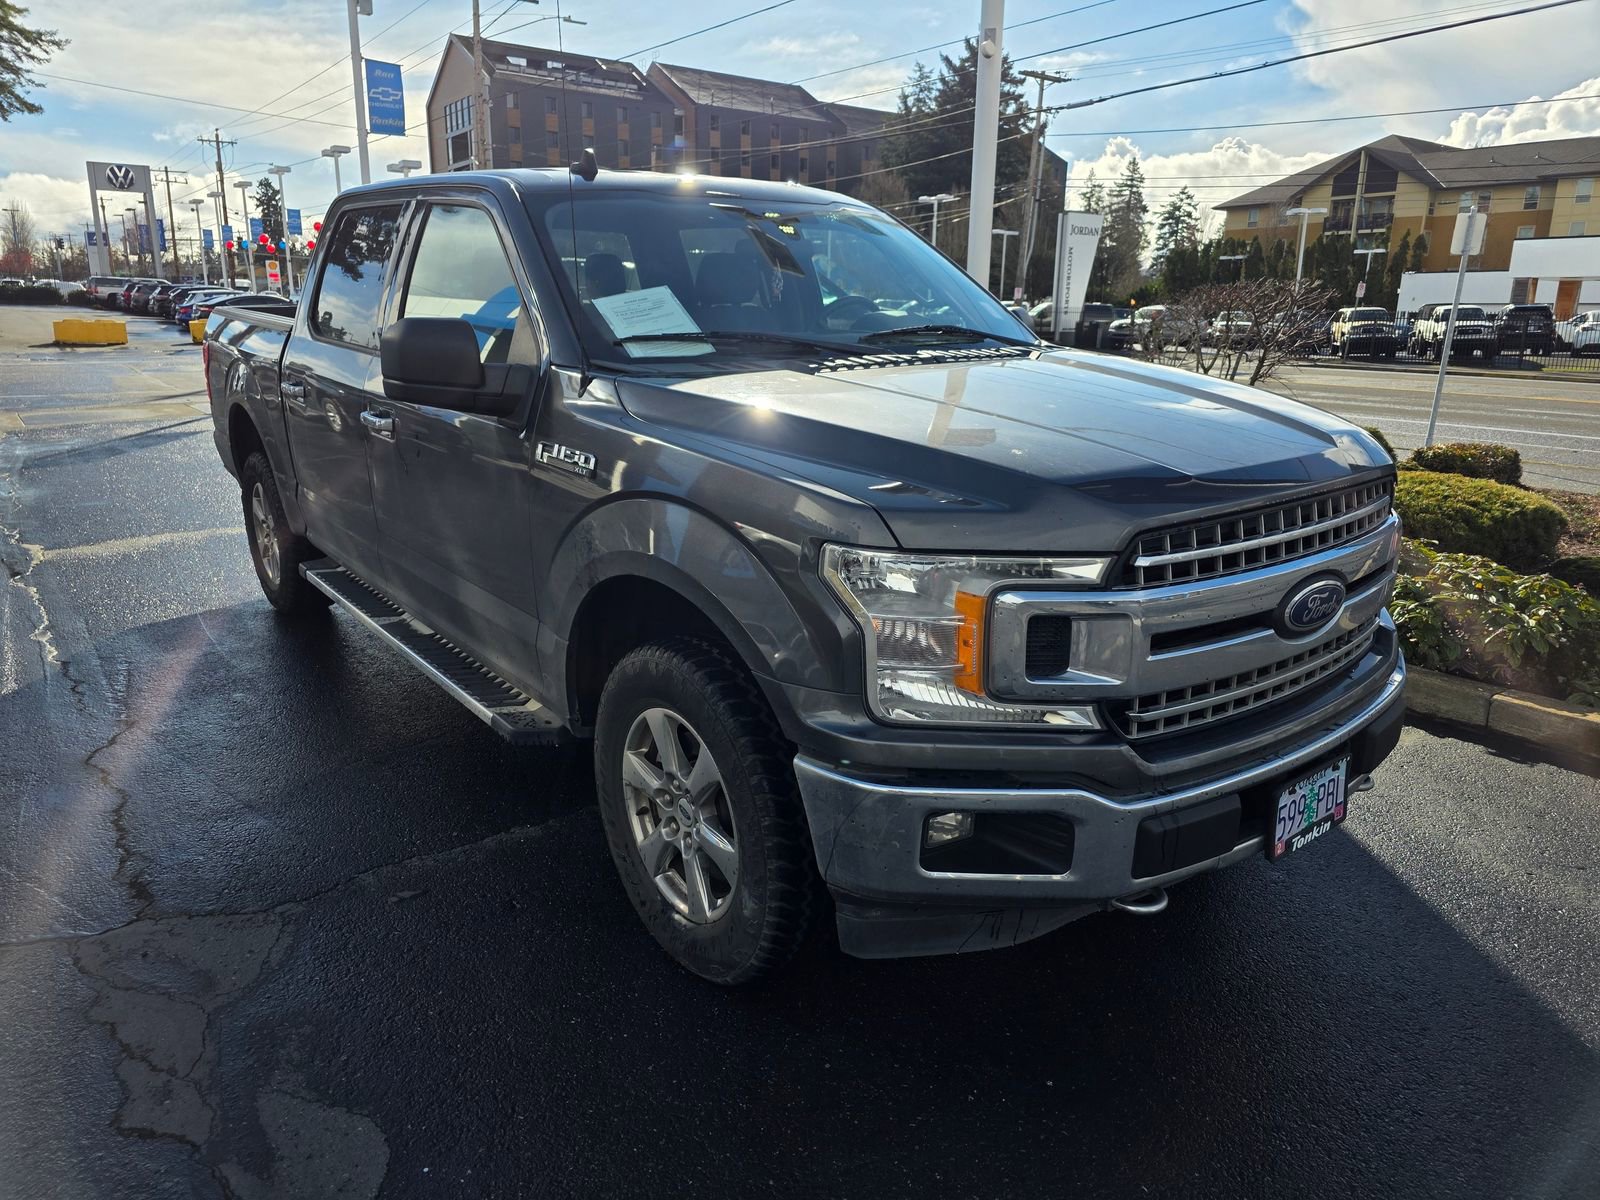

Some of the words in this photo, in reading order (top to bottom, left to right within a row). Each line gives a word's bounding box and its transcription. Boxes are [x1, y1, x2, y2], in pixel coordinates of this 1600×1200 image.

[1070, 224, 1099, 236] JORDAN
[1064, 247, 1073, 315] MOTORSPORTS
[574, 466, 586, 475] XLT
[1303, 592, 1337, 622] Ford
[1277, 793, 1307, 842] 599
[1315, 775, 1344, 818] PBL
[1292, 821, 1331, 852] Tonkin
